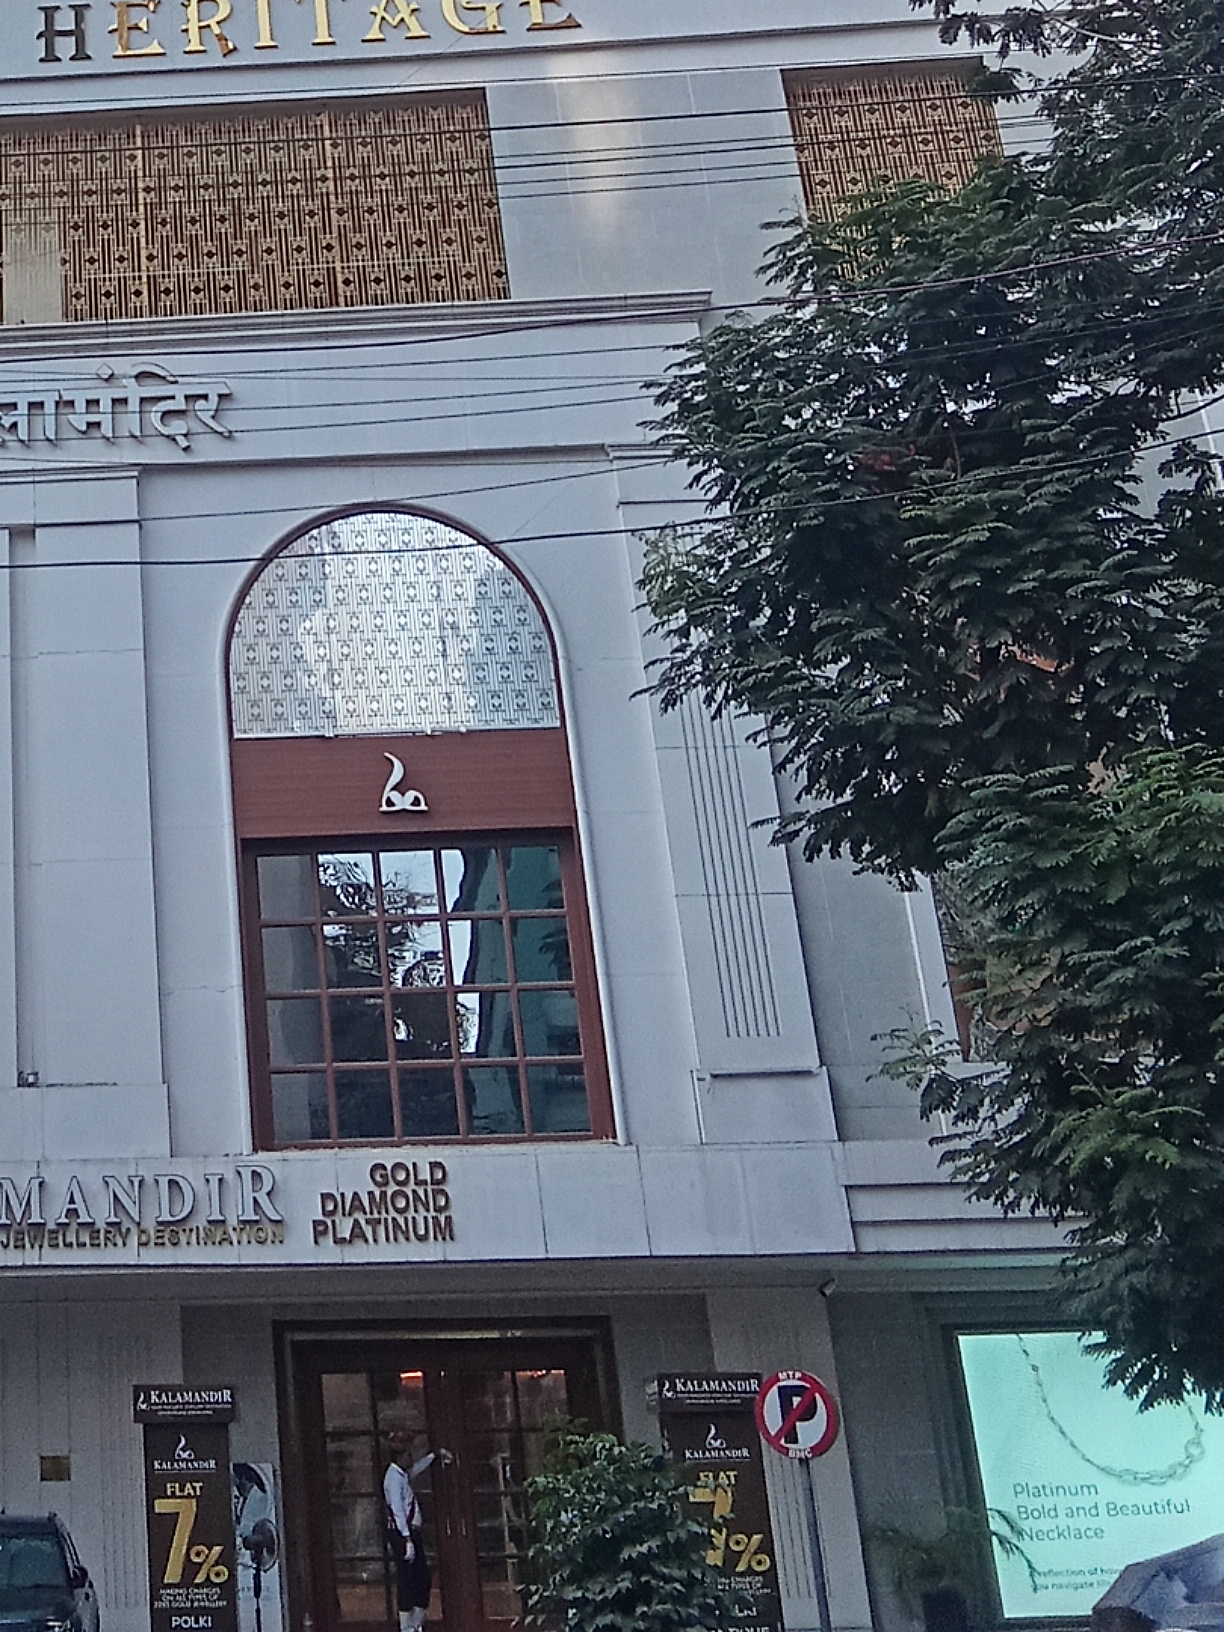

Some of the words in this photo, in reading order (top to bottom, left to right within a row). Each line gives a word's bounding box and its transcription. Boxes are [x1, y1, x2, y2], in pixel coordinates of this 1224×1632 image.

[369, 1161, 447, 1187] GOLD
[320, 1188, 450, 1217] DIAMOND
[0, 1226, 131, 1250] JEWELLERY
[137, 1223, 284, 1247] DESTINATION
[312, 1215, 455, 1245] PLATINUM
[778, 1371, 802, 1380] MTP
[675, 1378, 760, 1392] KALAMANDIR
[150, 1389, 232, 1403] KALAMANDIR
[684, 1448, 750, 1459] KALAMANDIR
[154, 1459, 216, 1470] KALAMANDIR
[166, 1482, 203, 1496] FLAT
[1013, 1482, 1098, 1498] Platinum
[1016, 1504, 1058, 1519] Bold
[1065, 1502, 1099, 1517] and
[1106, 1499, 1190, 1517] Beautiful
[154, 1499, 229, 1584] 7%
[1018, 1525, 1105, 1542] Necklace
[171, 1615, 213, 1629] POLKI
